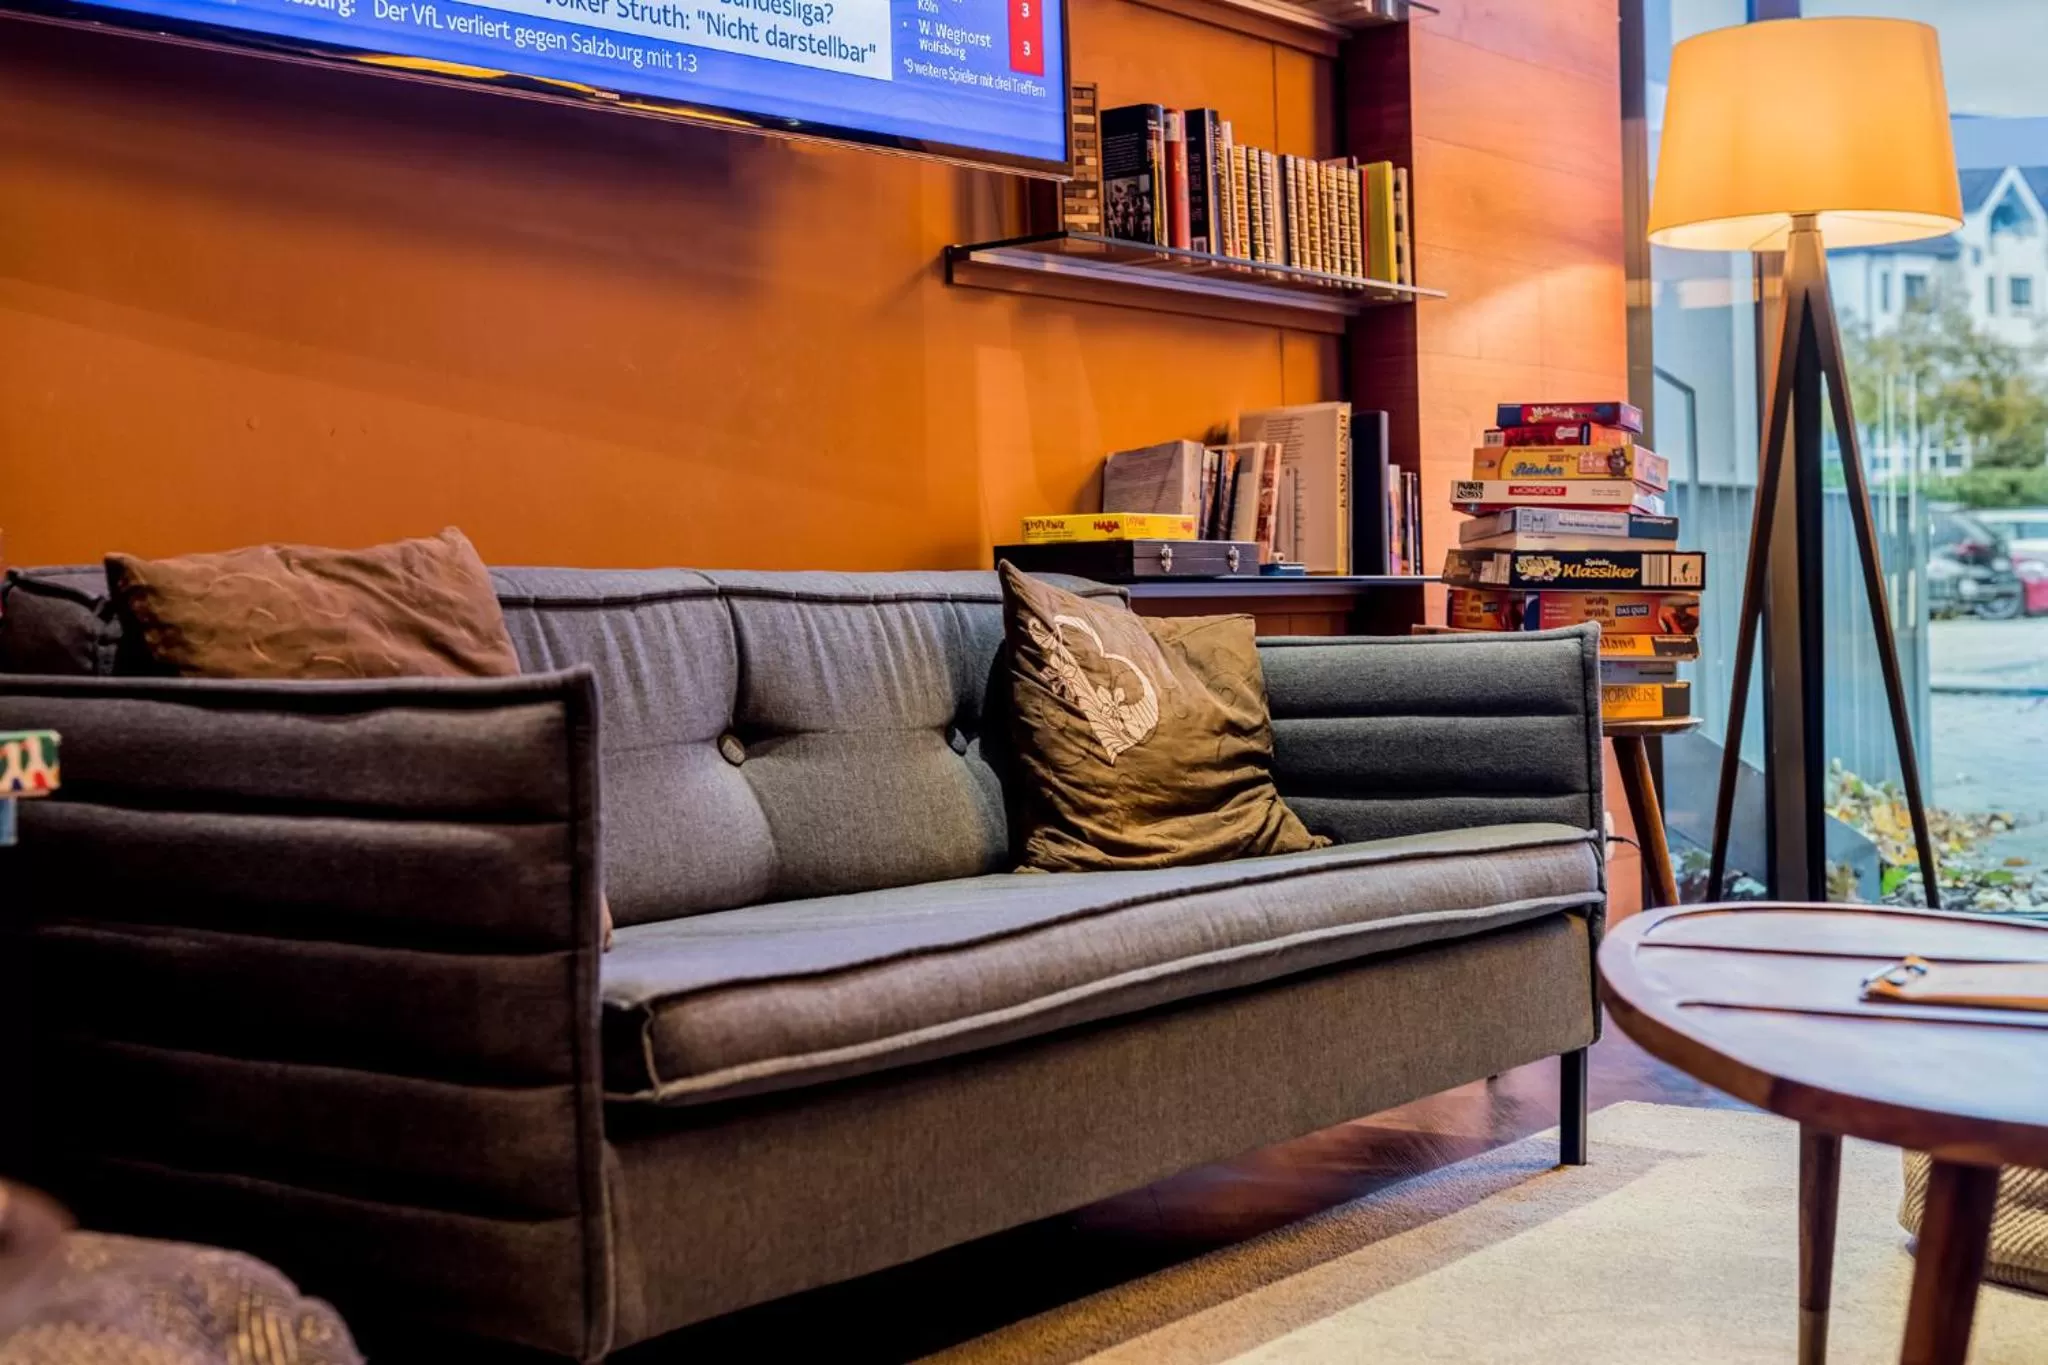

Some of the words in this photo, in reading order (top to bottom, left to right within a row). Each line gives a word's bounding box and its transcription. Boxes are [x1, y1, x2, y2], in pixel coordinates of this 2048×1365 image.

[720, 0, 834, 27] ndesliga?
[1021, 3, 1030, 18] 3
[284, 0, 357, 18] urg:
[374, 0, 409, 22] Der
[411, 3, 443, 29] VfL
[446, 13, 511, 41] verliert
[514, 26, 567, 51] gegen
[571, 32, 643, 69] Salzburg
[646, 48, 673, 69] mit
[675, 52, 697, 73] 1:3
[546, 0, 610, 15] ker
[617, 0, 690, 31] Struth:
[696, 9, 760, 44] "Nicht
[765, 24, 877, 64] darstellbar"
[918, 18, 933, 36] W.
[935, 22, 992, 49] Weghorst
[919, 38, 966, 62] Wolfsburg
[1023, 41, 1031, 56] 3
[915, 61, 948, 80] weitere
[1512, 486, 1563, 496] MONOPOLY
[1093, 520, 1120, 533] HABA
[1563, 564, 1640, 579] Klassiker
